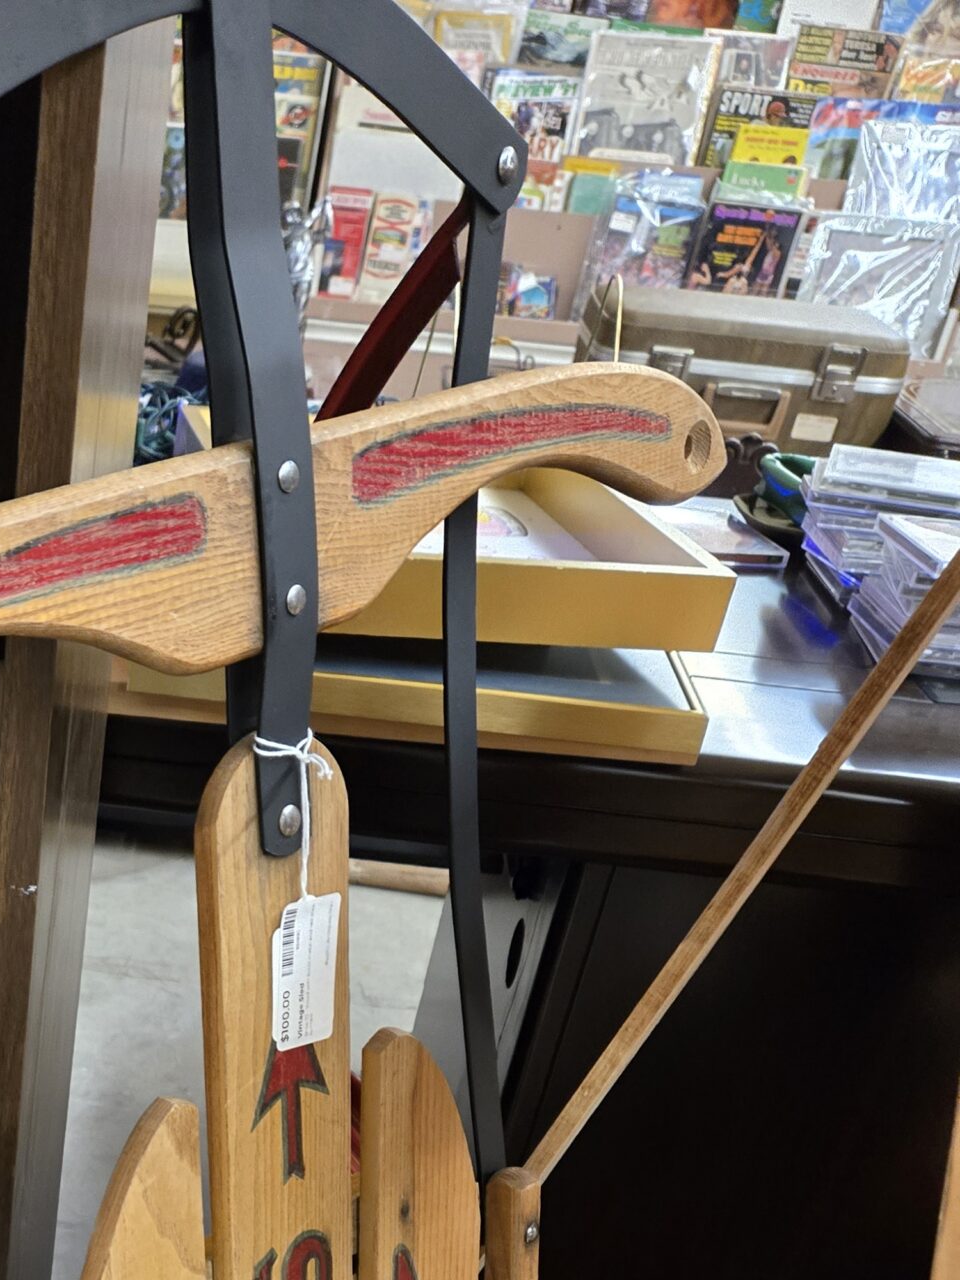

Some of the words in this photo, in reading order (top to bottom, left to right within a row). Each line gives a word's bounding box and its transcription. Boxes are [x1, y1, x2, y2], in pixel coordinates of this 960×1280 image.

[719, 90, 773, 118] SPORT
[280, 989, 291, 1043] $100.00
[297, 1003, 306, 1039] Vintage
